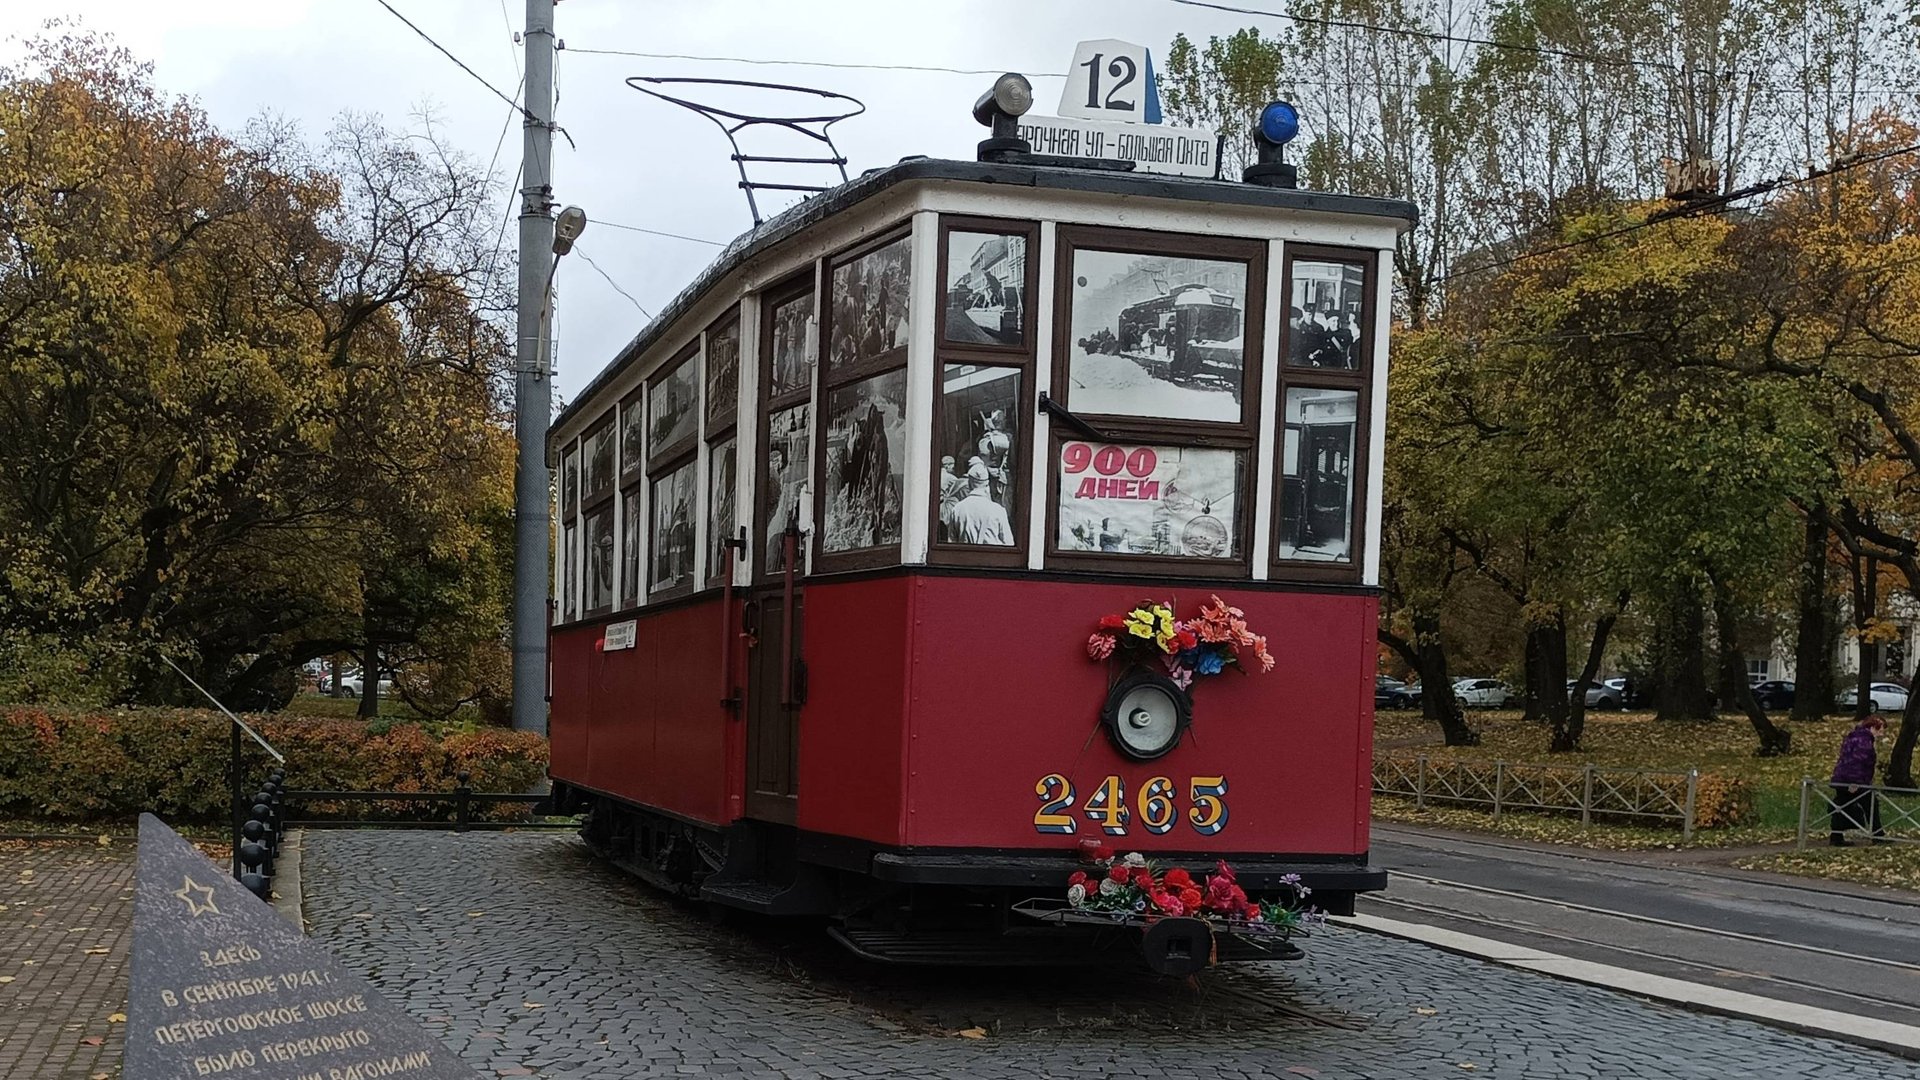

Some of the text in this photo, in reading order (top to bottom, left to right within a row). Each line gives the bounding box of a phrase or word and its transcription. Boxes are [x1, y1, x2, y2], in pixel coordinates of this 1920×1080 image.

[1080, 53, 1137, 111] 12
[1063, 443, 1157, 478] 900
[1075, 476, 1160, 501] ДНЕЙ
[1034, 773, 1230, 836] 2465
[200, 944, 262, 968] ЗДЕСЬ
[161, 989, 179, 1008] В
[182, 975, 278, 1005] СЕНТЯБРЕ
[278, 969, 322, 992] 1941
[154, 994, 368, 1046] ПЕТЕРГОФСКОЕ ШОССЕ
[193, 1029, 370, 1077] БЫЛО ПЕРЕКРЫТО
[328, 1049, 432, 1080] ВАГОНАМИ
